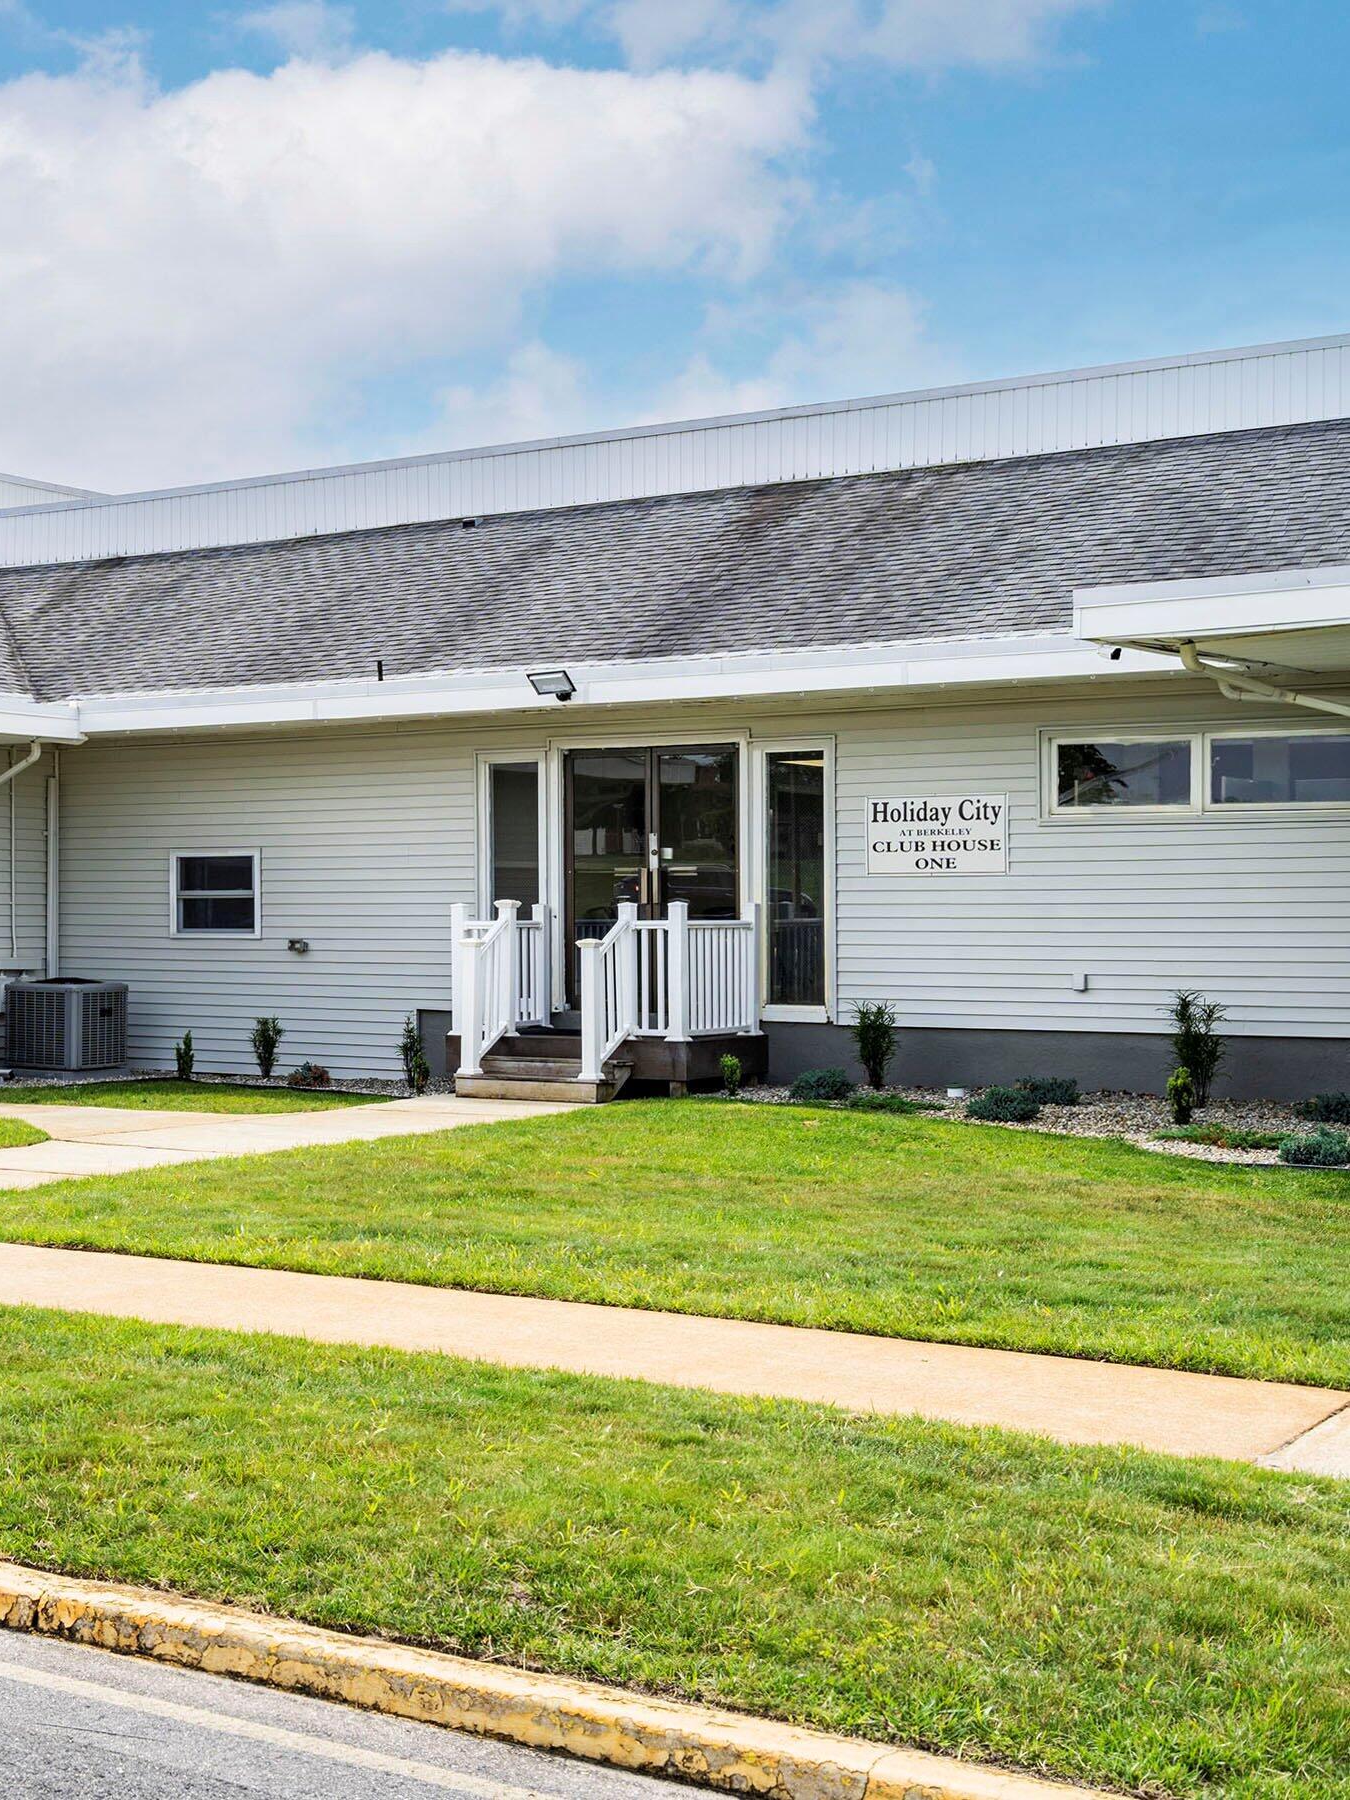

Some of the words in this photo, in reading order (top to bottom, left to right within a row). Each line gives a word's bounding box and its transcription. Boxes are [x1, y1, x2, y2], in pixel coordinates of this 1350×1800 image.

[871, 800, 952, 826] Holiday
[958, 799, 1002, 825] City
[900, 828, 914, 837] AT
[916, 827, 973, 837] BERKELEY
[872, 840, 926, 853] CLUB
[931, 839, 1002, 852] HOUSE
[915, 857, 957, 870] ONE
